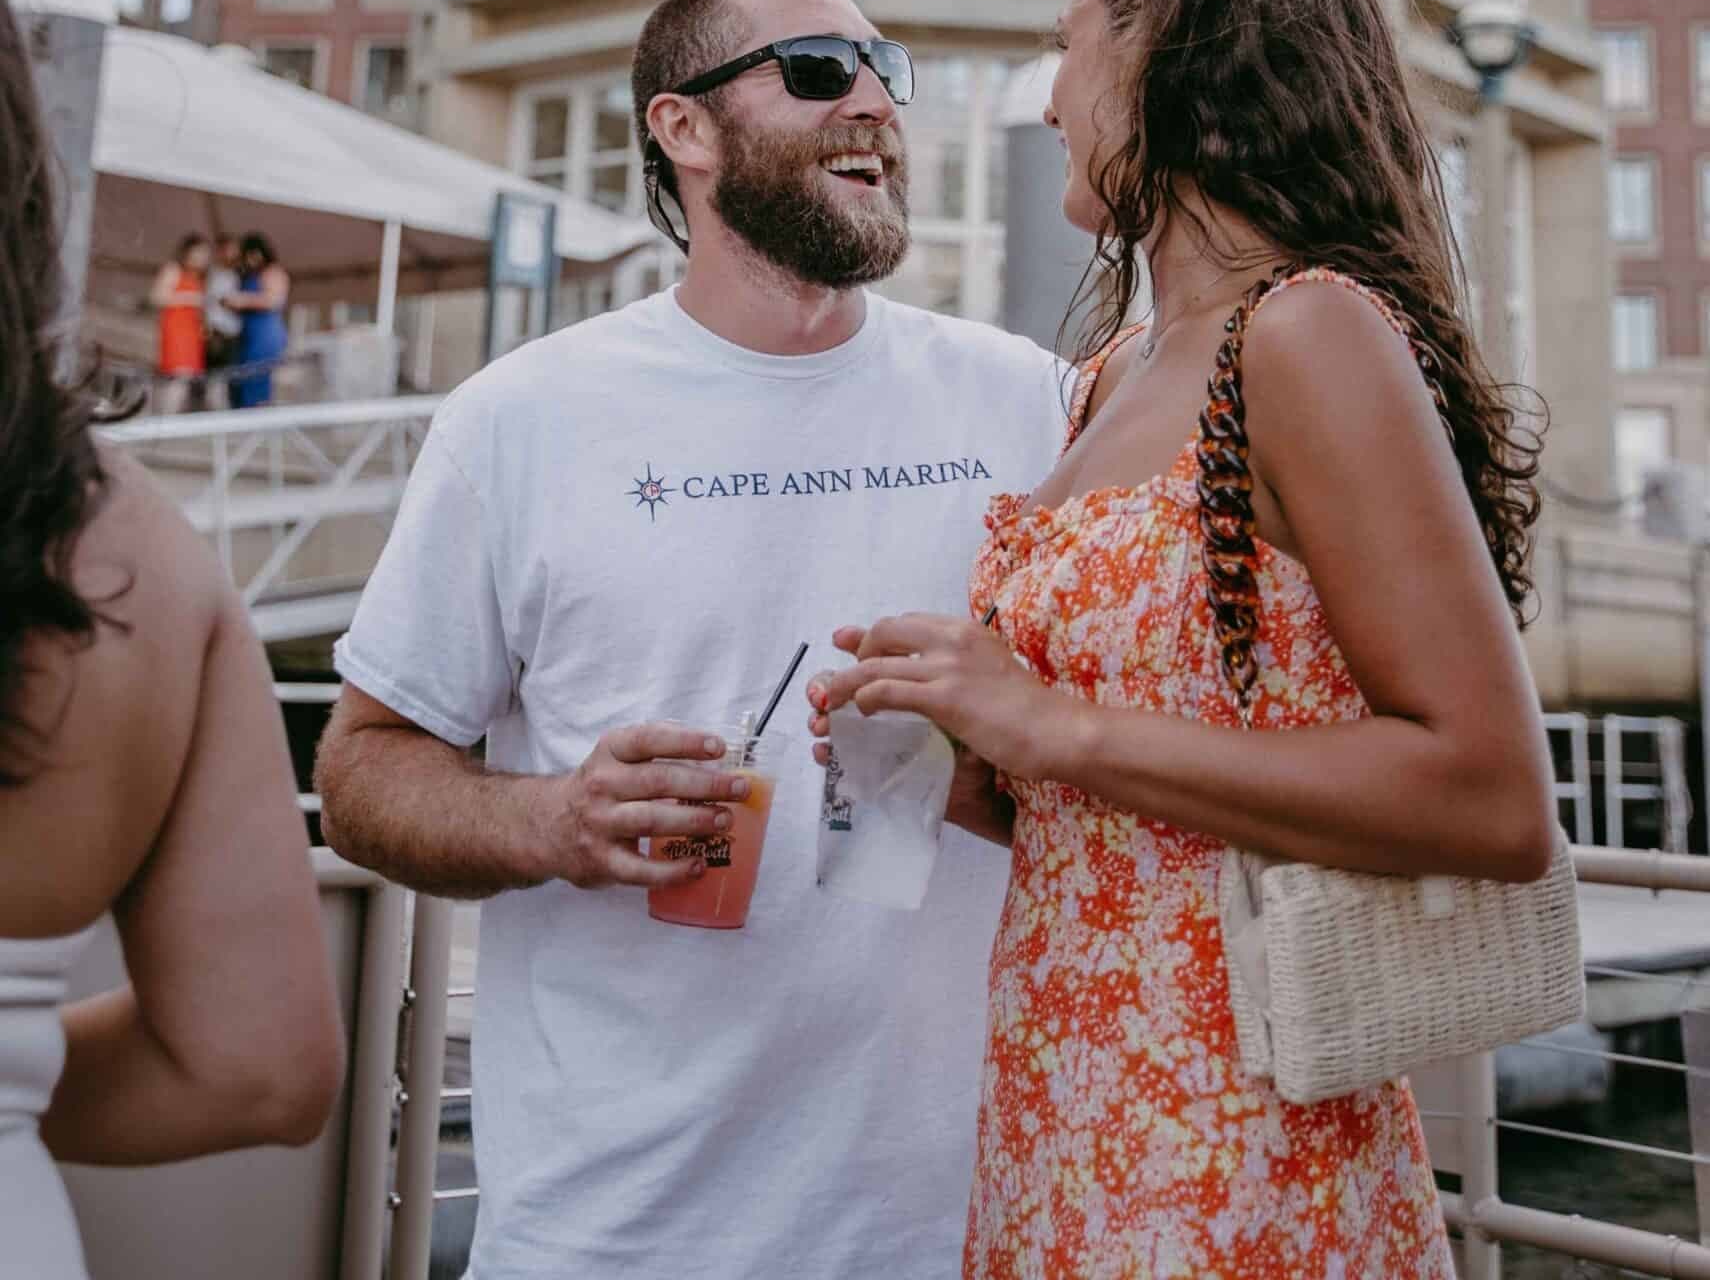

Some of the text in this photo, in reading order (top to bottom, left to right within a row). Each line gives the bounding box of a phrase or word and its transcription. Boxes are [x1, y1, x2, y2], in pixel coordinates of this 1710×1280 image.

[683, 473, 770, 499] CAPE
[780, 468, 853, 496] ANN
[862, 458, 993, 489] MARINA
